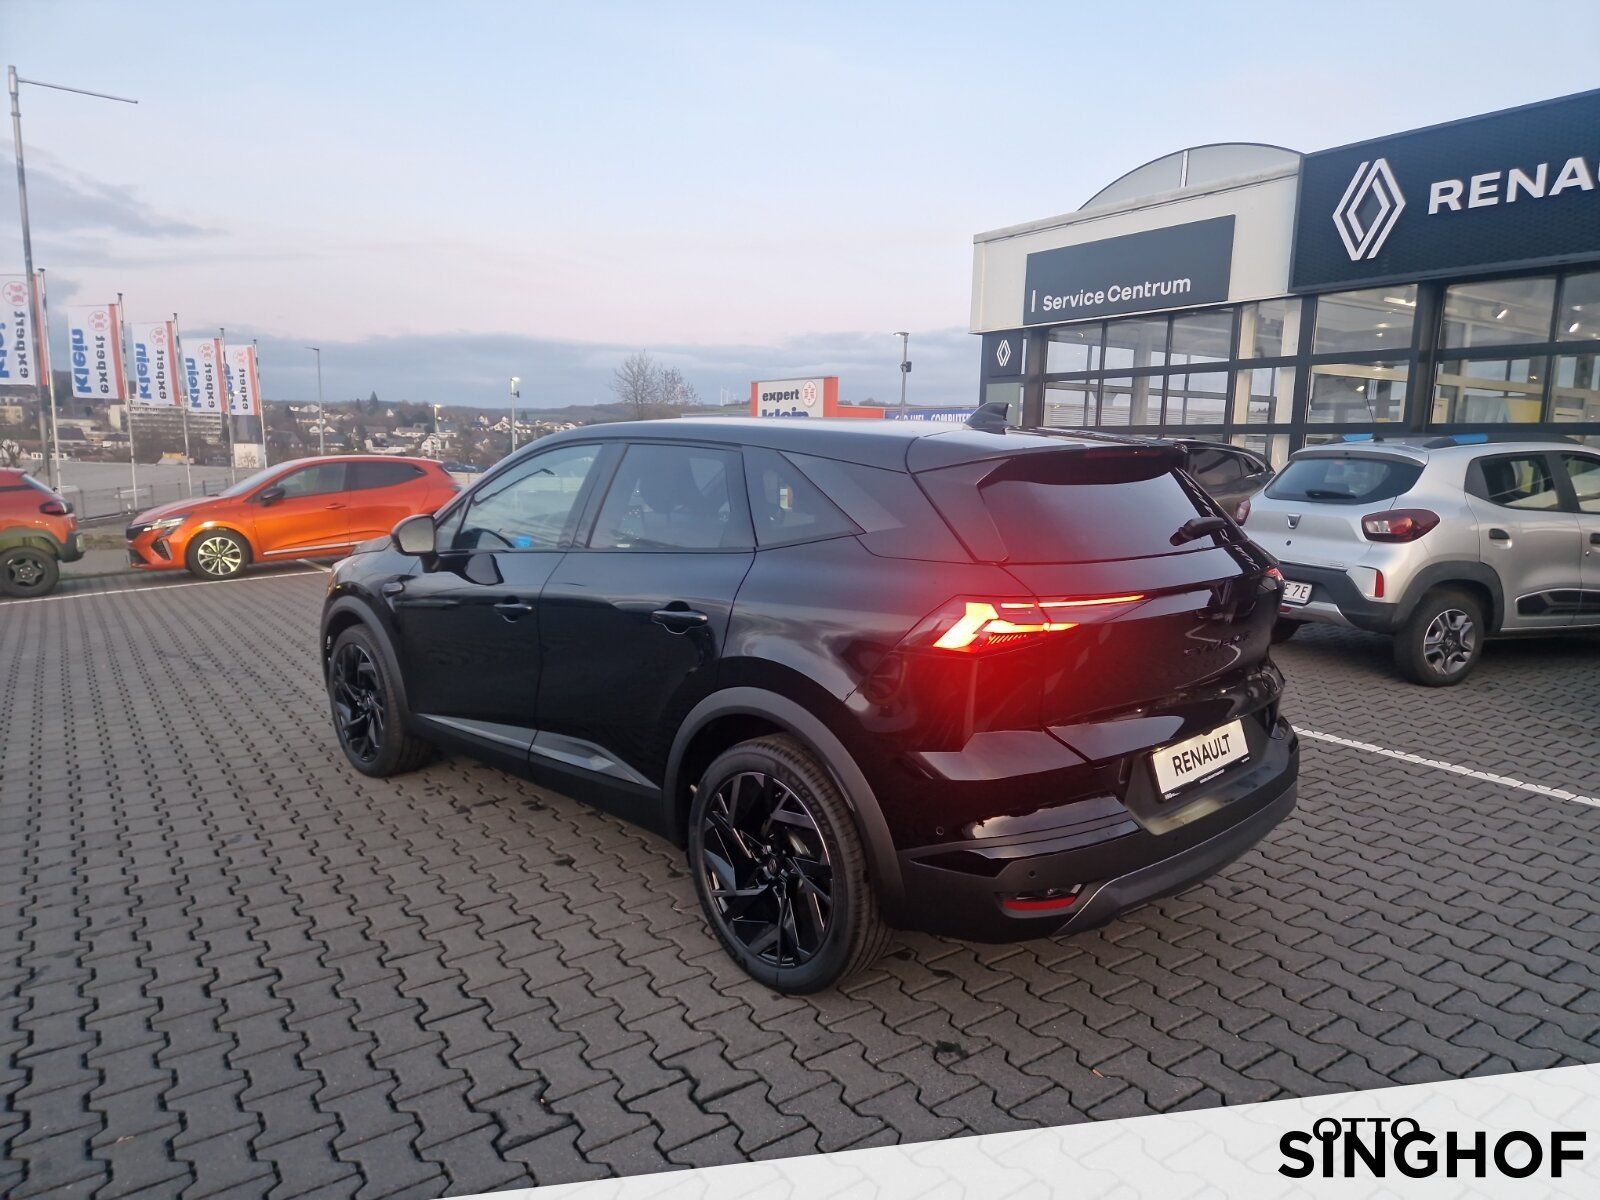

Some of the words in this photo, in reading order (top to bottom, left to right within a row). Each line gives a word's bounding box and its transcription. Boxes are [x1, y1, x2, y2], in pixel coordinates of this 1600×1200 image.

[1426, 156, 1600, 213] RENA
[1043, 290, 1103, 312] Service
[1108, 277, 1191, 303] Centrum
[762, 388, 799, 403] expert
[1292, 584, 1309, 599] 7E
[1172, 733, 1231, 777] RENAULT
